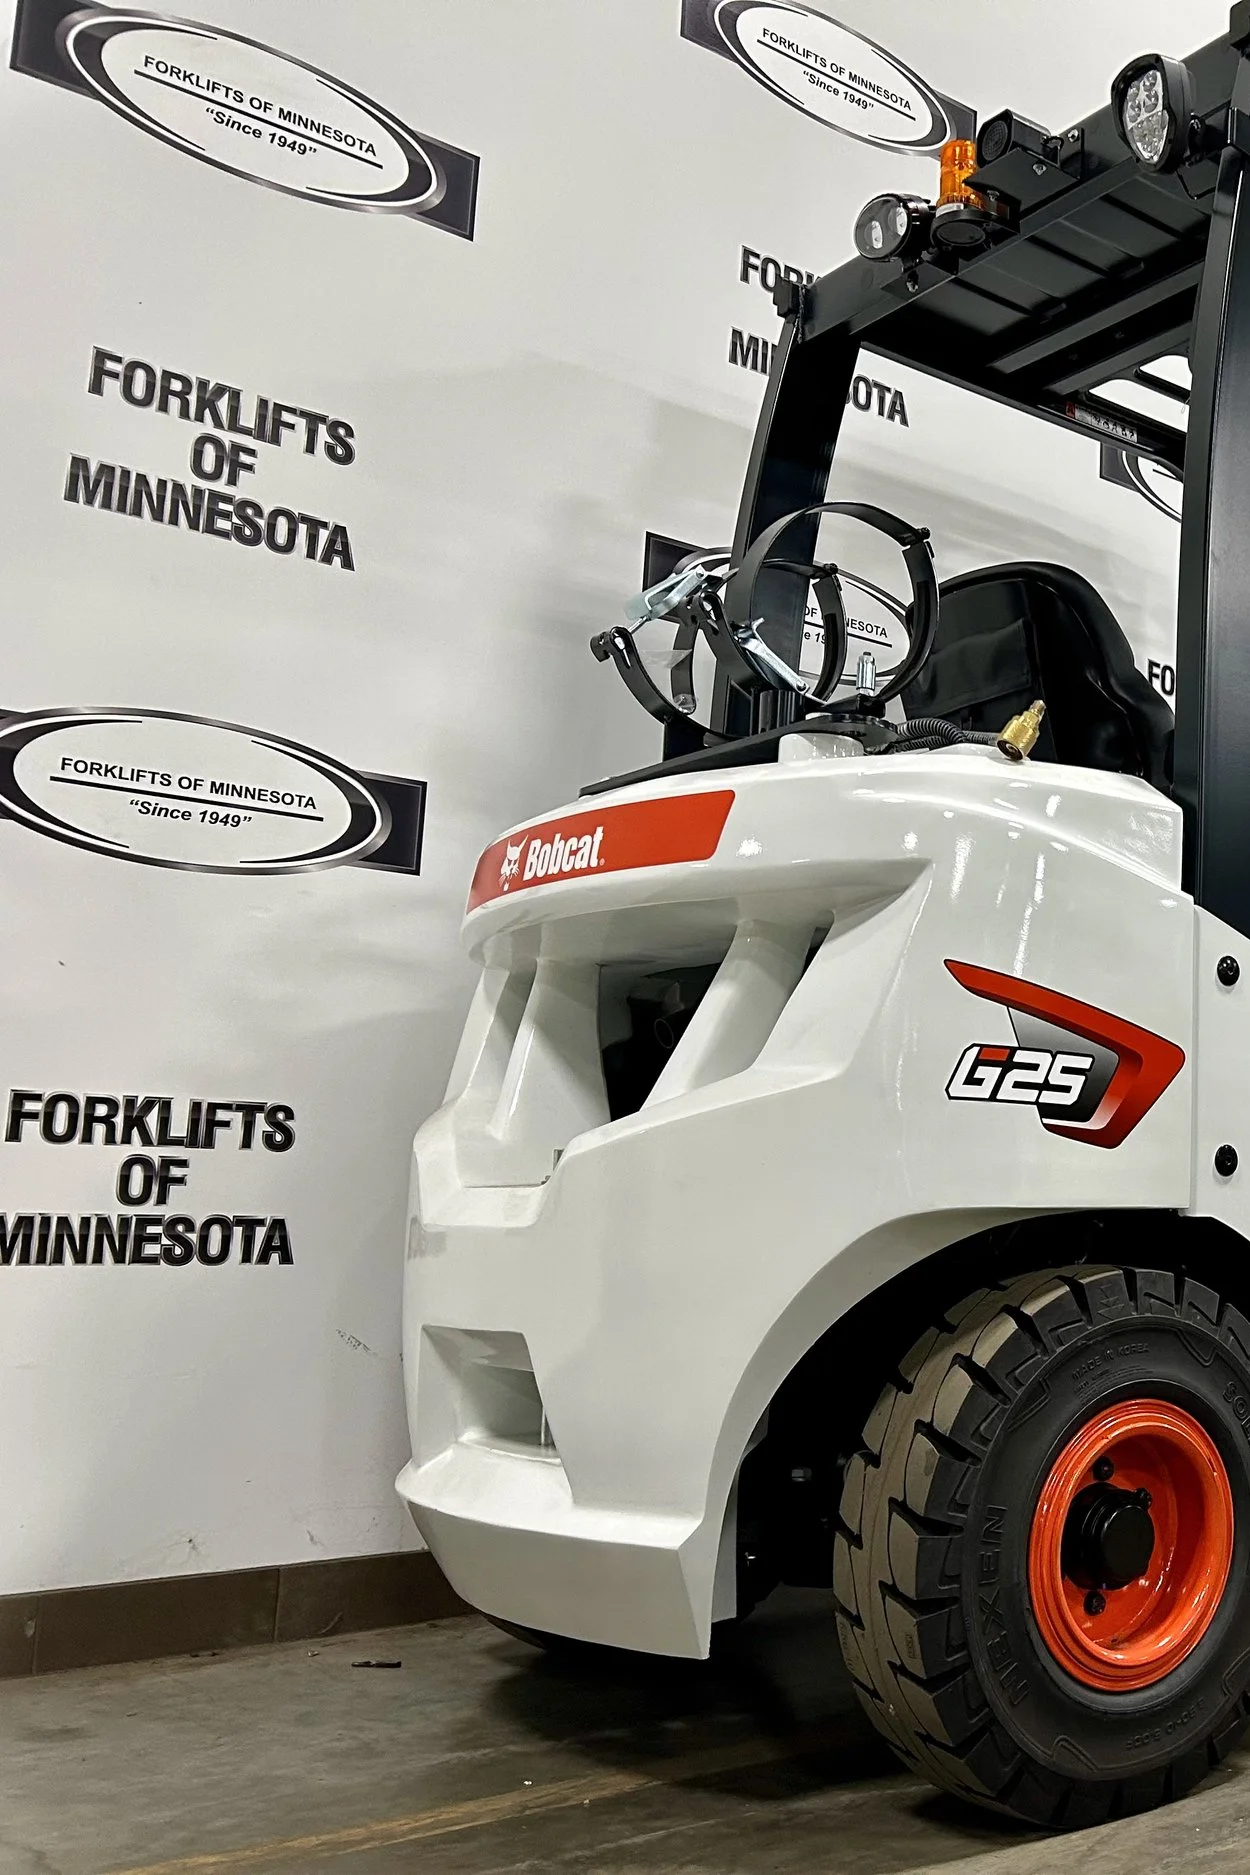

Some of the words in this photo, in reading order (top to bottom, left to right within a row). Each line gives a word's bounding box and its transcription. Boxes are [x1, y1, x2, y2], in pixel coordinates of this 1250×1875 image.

[762, 28, 827, 68] FORKLIFTS
[830, 62, 846, 77] OF
[848, 71, 912, 111] MINNESOTA
[144, 55, 244, 103] FORKLIFTS
[249, 96, 273, 114] OF
[278, 107, 377, 157] MINNESOTA
[87, 345, 356, 466] FORKLIFTS
[190, 432, 258, 487] OF
[63, 452, 355, 572] MINNESOTA
[60, 757, 172, 787] FORKLIFTS
[177, 776, 204, 791] OF
[209, 781, 317, 810] MINNESOTA
[523, 826, 604, 881] Bobcat
[945, 1044, 1095, 1106] G25
[4, 1088, 296, 1153] FORKLIFTS
[115, 1153, 190, 1207] OF
[0, 1212, 294, 1267] MINNESOTA
[978, 1504, 1030, 1706] NEXEN
